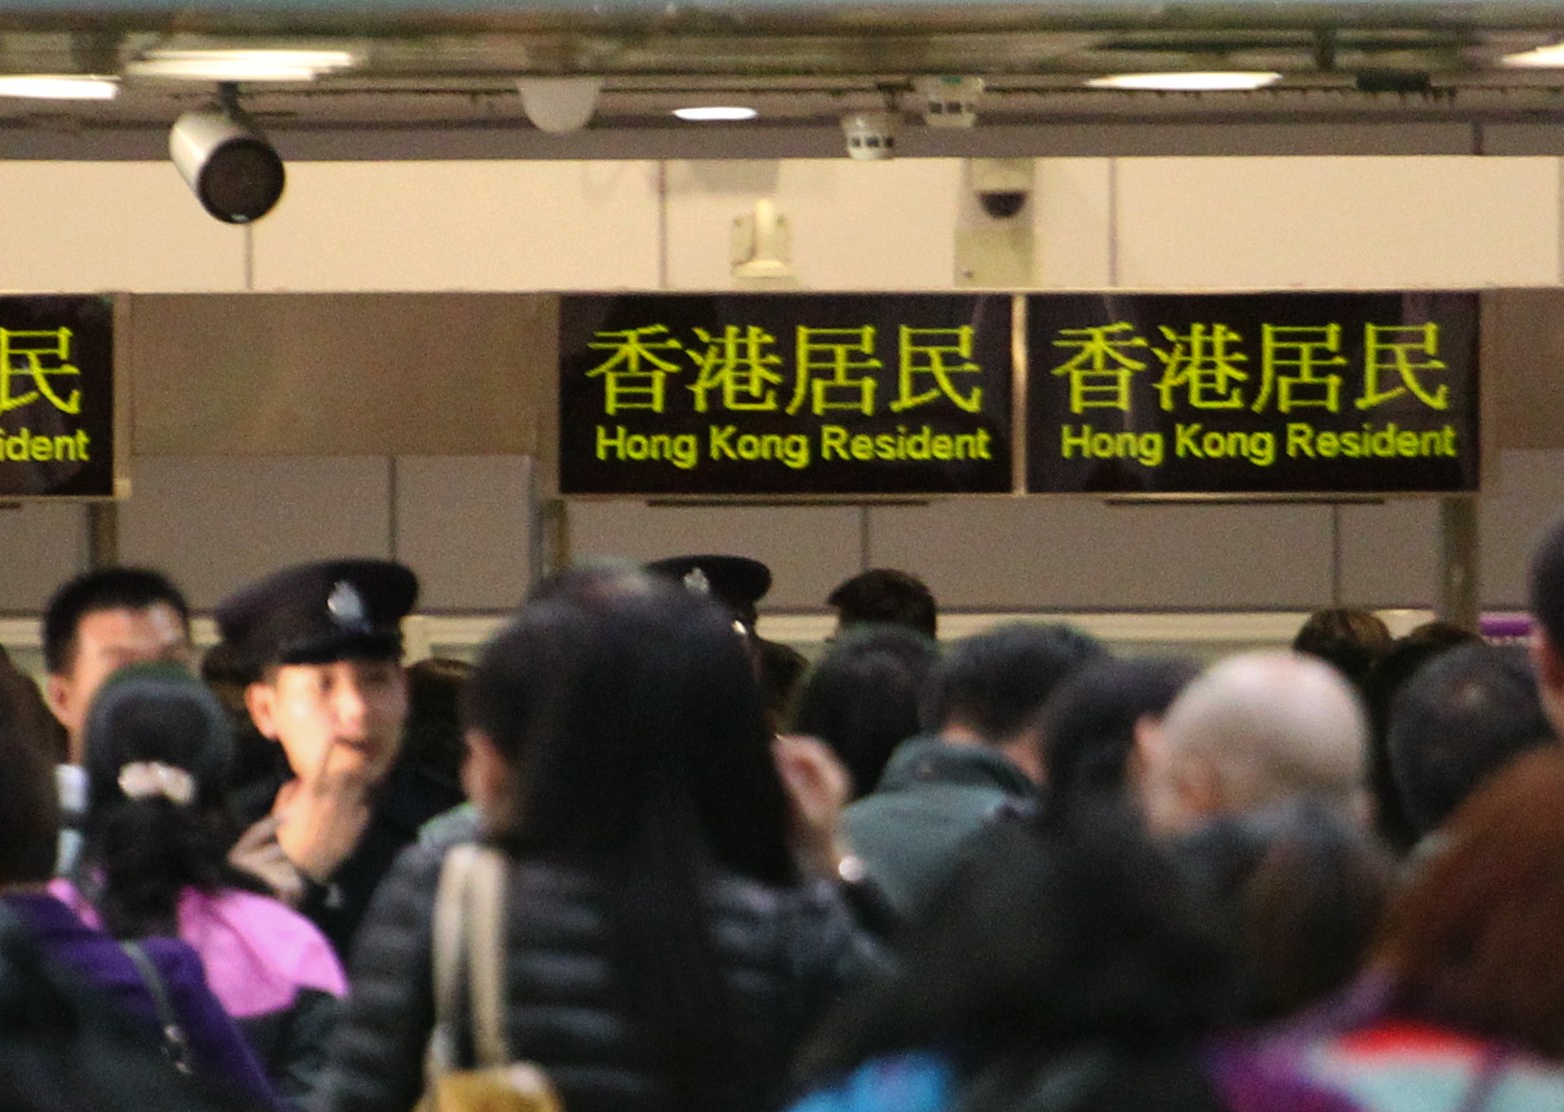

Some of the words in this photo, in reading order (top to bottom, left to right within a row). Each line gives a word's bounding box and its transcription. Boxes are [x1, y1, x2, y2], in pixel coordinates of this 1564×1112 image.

[587, 325, 983, 416] 香港居民
[1053, 322, 1449, 414] 香港居民
[597, 428, 698, 469] Hong
[711, 427, 810, 469] Kong
[822, 427, 991, 460] Resident
[1063, 426, 1164, 467] Hong
[1176, 425, 1275, 466] Kong
[1288, 424, 1456, 457] Resident
